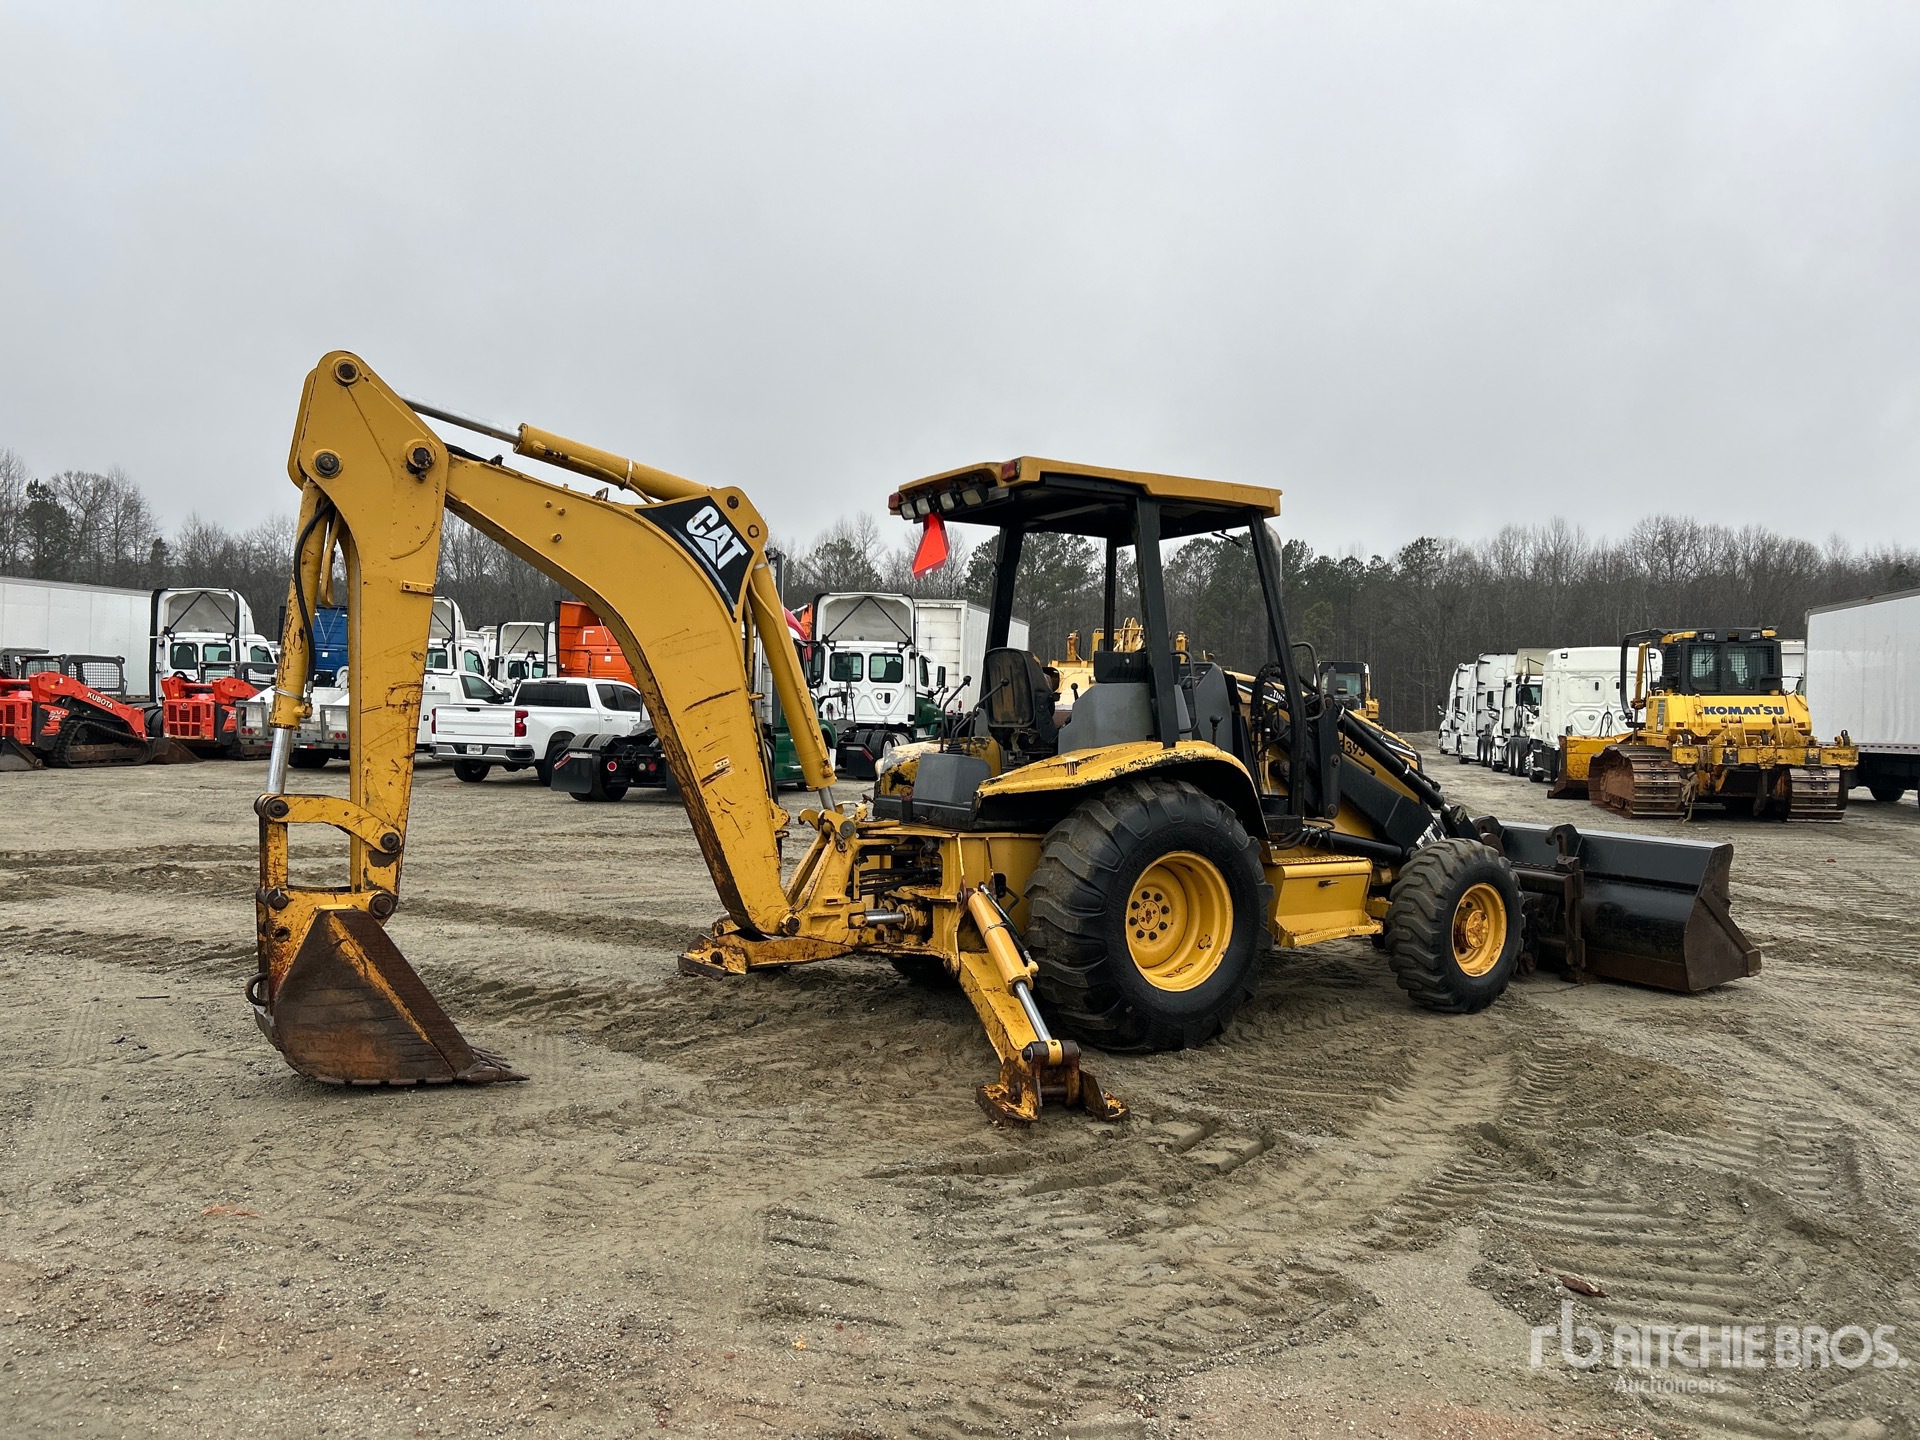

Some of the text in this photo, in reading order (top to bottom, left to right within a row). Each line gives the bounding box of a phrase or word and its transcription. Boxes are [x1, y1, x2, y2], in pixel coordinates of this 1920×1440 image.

[686, 505, 748, 570] CAT
[87, 691, 113, 709] KUBOTA
[1703, 705, 1785, 715] KOMATSU
